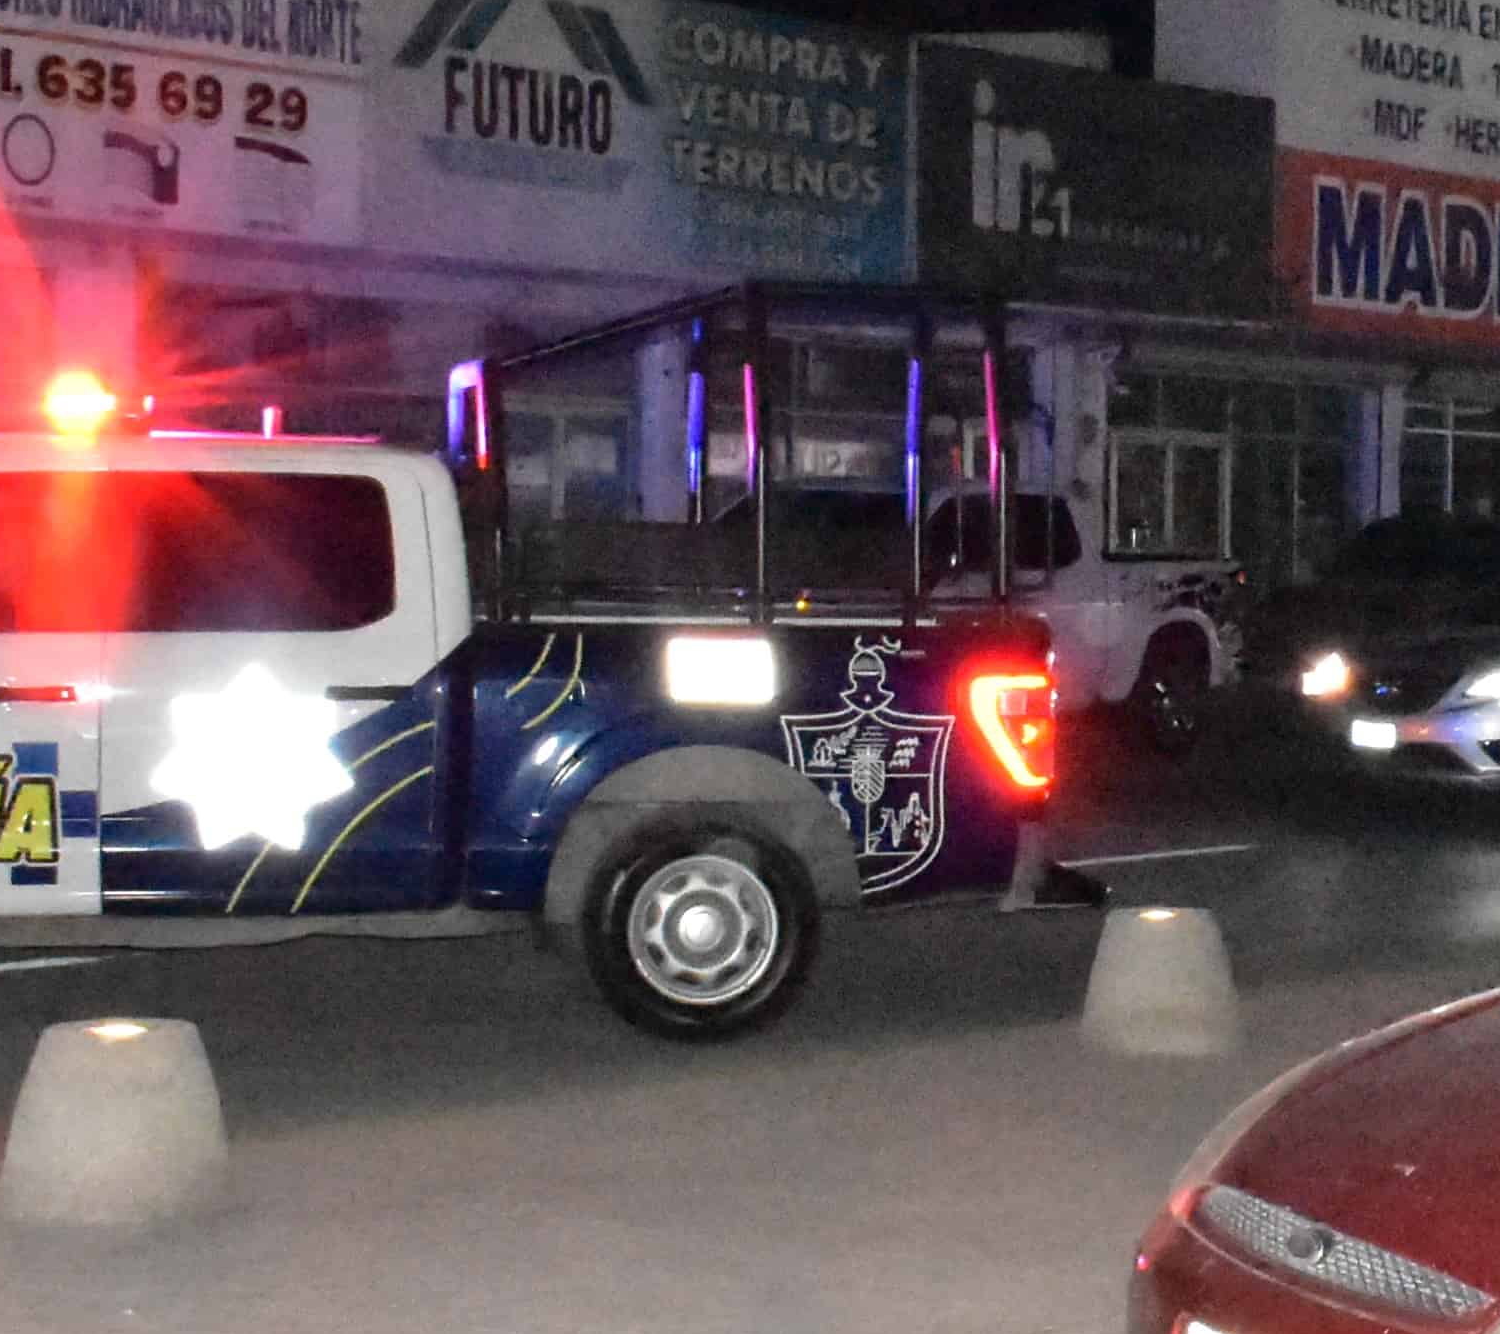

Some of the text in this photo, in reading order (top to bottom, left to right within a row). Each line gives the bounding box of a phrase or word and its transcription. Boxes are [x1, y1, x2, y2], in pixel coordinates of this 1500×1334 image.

[666, 18, 885, 91] COMPRA Y
[1360, 34, 1464, 91] MADERA
[37, 53, 137, 110] 635
[158, 70, 224, 121] 69
[244, 82, 308, 133] 29
[444, 56, 613, 155] FUTURO
[676, 83, 879, 149] VENTA DE
[1373, 98, 1428, 143] MDF
[669, 137, 882, 206] TERRENOS
